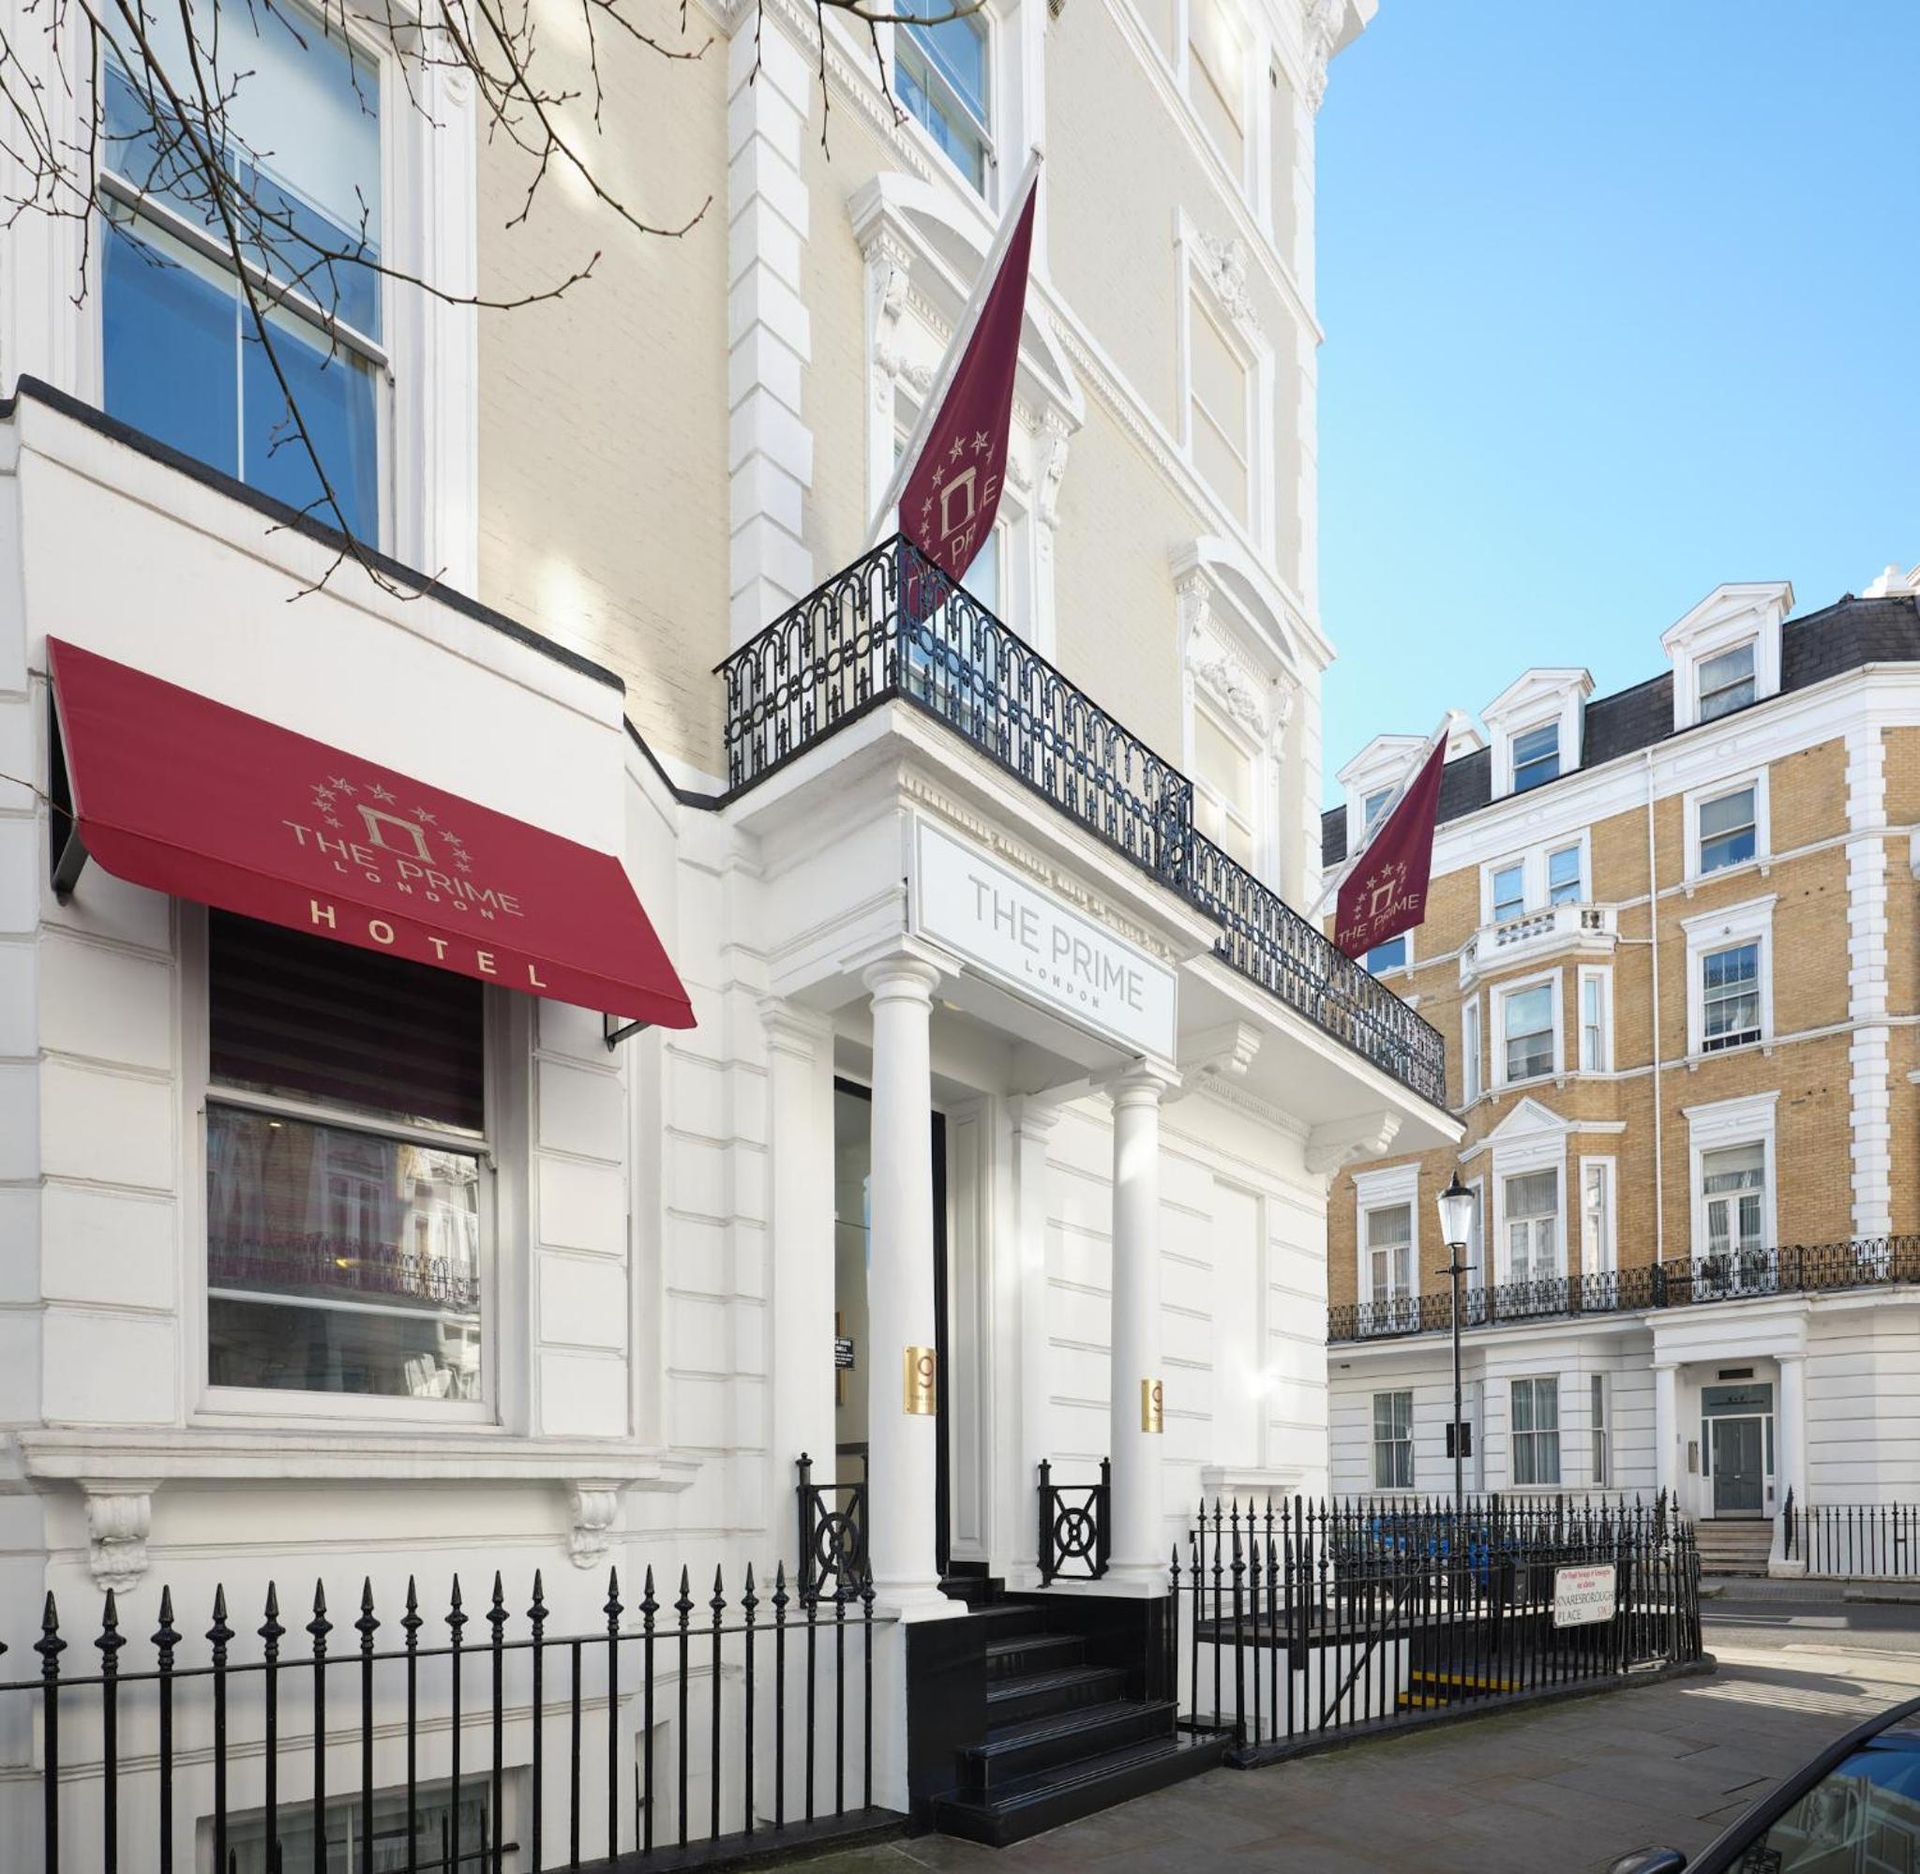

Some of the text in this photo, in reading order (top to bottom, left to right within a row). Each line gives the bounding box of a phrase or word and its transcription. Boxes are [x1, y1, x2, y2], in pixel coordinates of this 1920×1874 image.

[282, 820, 525, 916] THE PRIME
[334, 860, 495, 920] LONDON
[310, 899, 548, 988] HOTEL
[968, 874, 1144, 1012] THE PRIME
[1338, 923, 1368, 946] THE
[1025, 959, 1101, 1008] LONDON
[917, 1355, 934, 1388] 9
[1557, 1609, 1582, 1623] PLACE
